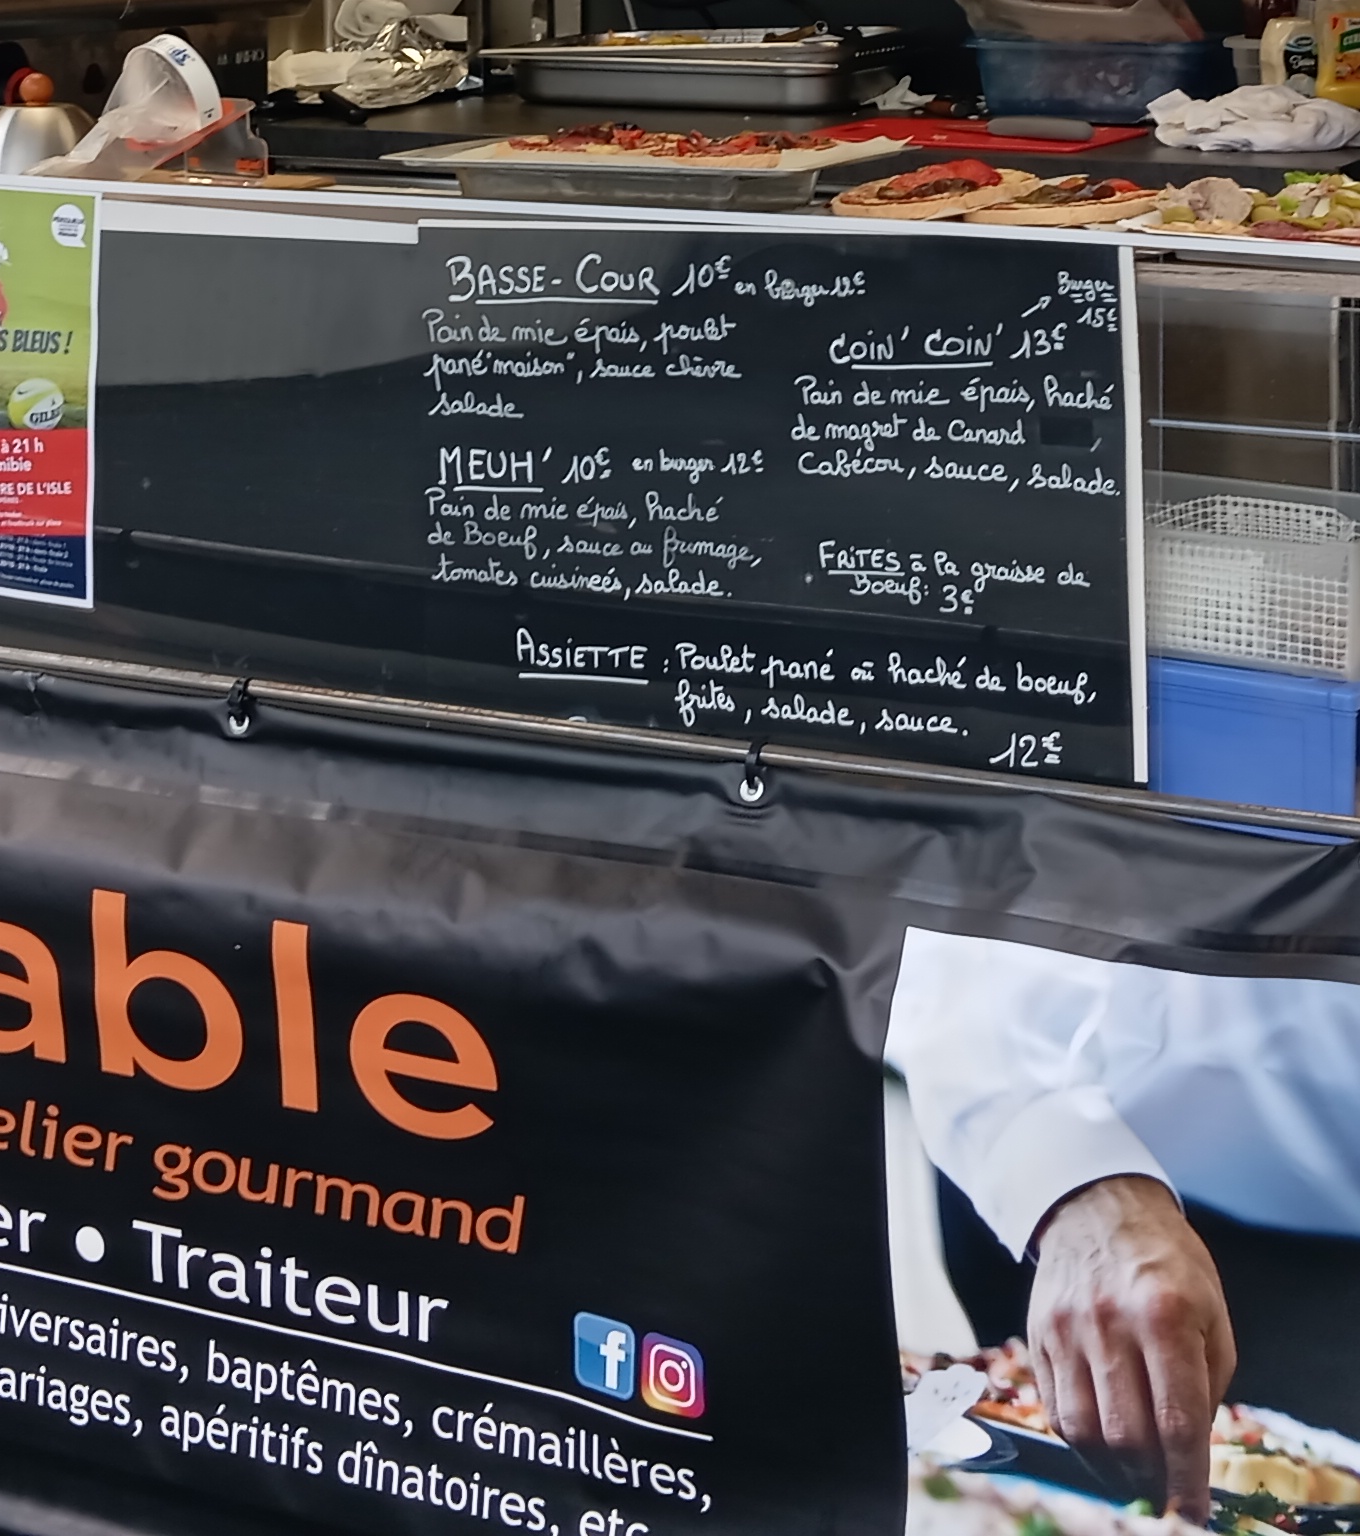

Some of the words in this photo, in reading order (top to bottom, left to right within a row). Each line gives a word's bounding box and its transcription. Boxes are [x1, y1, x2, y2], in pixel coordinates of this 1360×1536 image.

[12, 330, 61, 353] BLEUS
[422, 308, 474, 343] Pain
[478, 314, 507, 342] de
[512, 319, 568, 345] mie
[575, 318, 647, 354] épais,
[653, 314, 737, 355] poulet
[424, 350, 488, 391] pané
[590, 358, 655, 378] sauce
[428, 391, 524, 418] salade
[1, 439, 9, 454] à
[13, 439, 29, 452] 21
[35, 438, 44, 452] h
[791, 413, 820, 441] de
[825, 414, 907, 451] magret
[912, 417, 941, 442] de
[947, 419, 1026, 445] Canard
[18, 482, 34, 495] DE
[925, 455, 1020, 493] sauce,
[1027, 464, 1121, 497] salade.
[819, 540, 901, 571] FRITES
[934, 551, 959, 576] la
[971, 559, 1045, 592] graisse
[1057, 563, 1090, 587] de
[517, 628, 648, 669] ASSIETTE
[675, 642, 756, 673] Poulet
[761, 648, 835, 688] pané
[888, 652, 967, 689] haché
[975, 665, 1006, 692] de
[152, 1143, 525, 1255] gourmand
[133, 1218, 450, 1344] Traiteur
[160, 1404, 323, 1476] apéritifs
[207, 1339, 414, 1438] baptêmes,
[432, 1402, 712, 1513] crémaillères,
